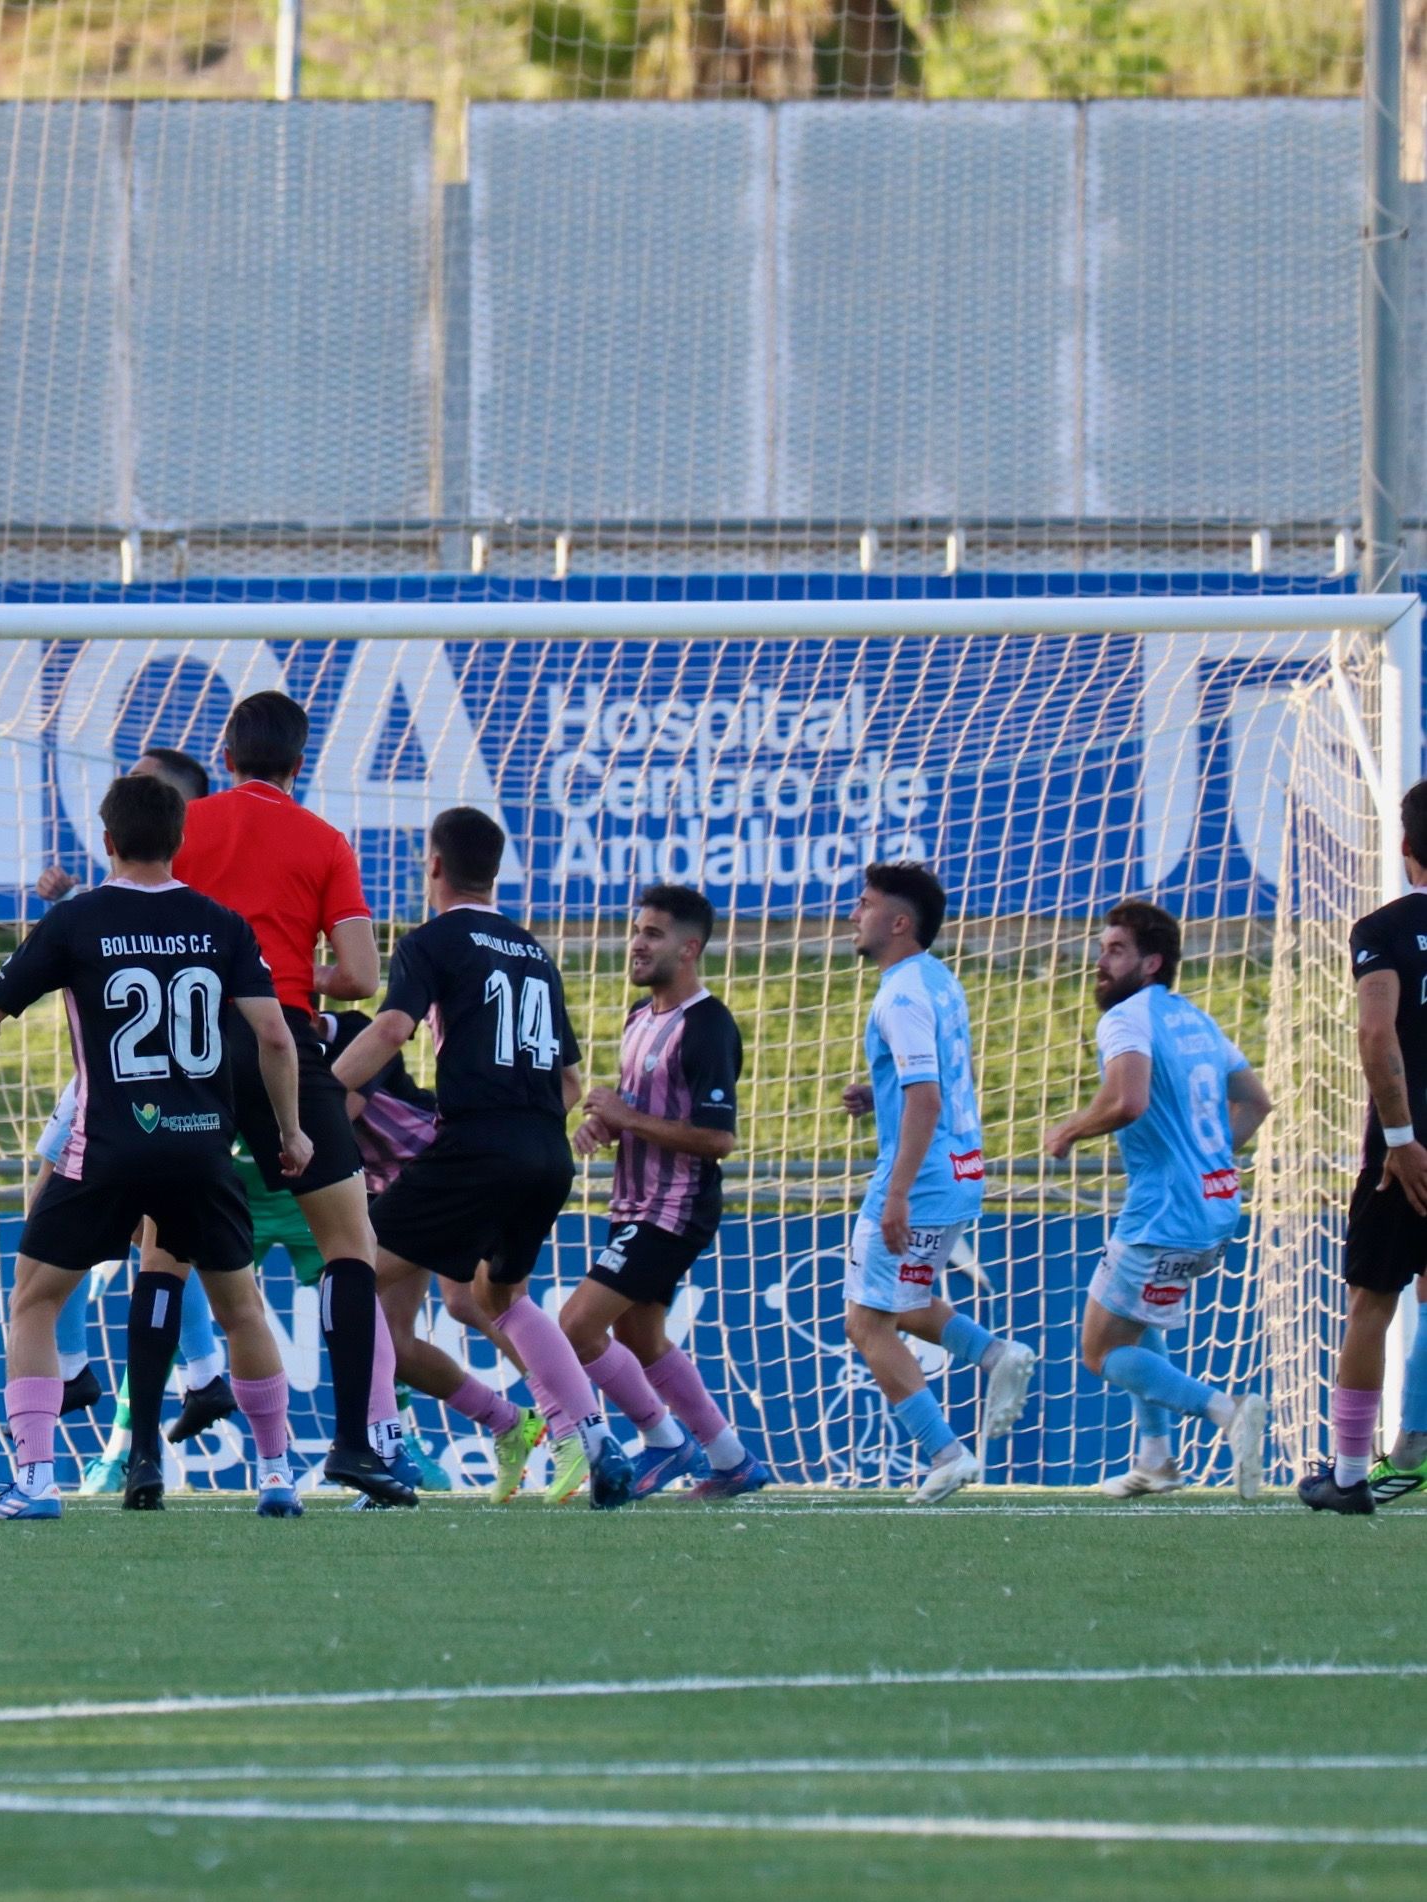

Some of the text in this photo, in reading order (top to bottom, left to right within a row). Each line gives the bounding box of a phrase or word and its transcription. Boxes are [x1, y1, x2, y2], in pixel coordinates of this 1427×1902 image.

[546, 683, 866, 770] Hospital
[548, 750, 929, 822] Centro de
[101, 934, 217, 957] BOLLULLOS C.F.
[470, 932, 526, 957] BOLLULLOS
[103, 966, 223, 1083] 20
[484, 969, 559, 1071] 14
[1189, 1063, 1227, 1155] 8
[610, 1224, 639, 1253] 2
